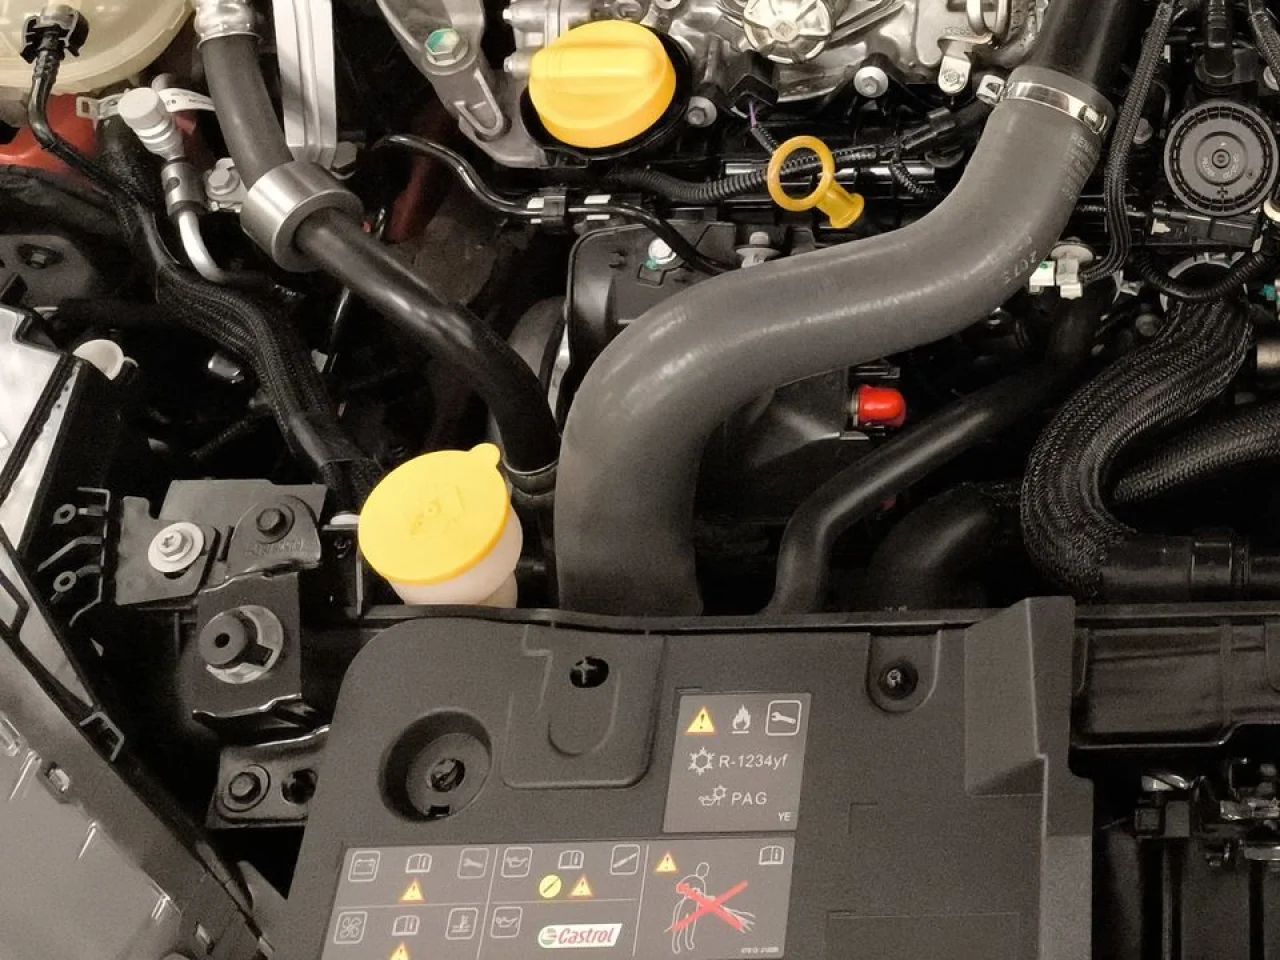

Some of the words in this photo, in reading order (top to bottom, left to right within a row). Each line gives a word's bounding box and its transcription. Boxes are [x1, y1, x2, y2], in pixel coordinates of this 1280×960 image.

[719, 753, 789, 770] R-1234yf
[731, 791, 768, 806] PAG
[778, 811, 791, 822] YE
[558, 927, 615, 945] Castrol
